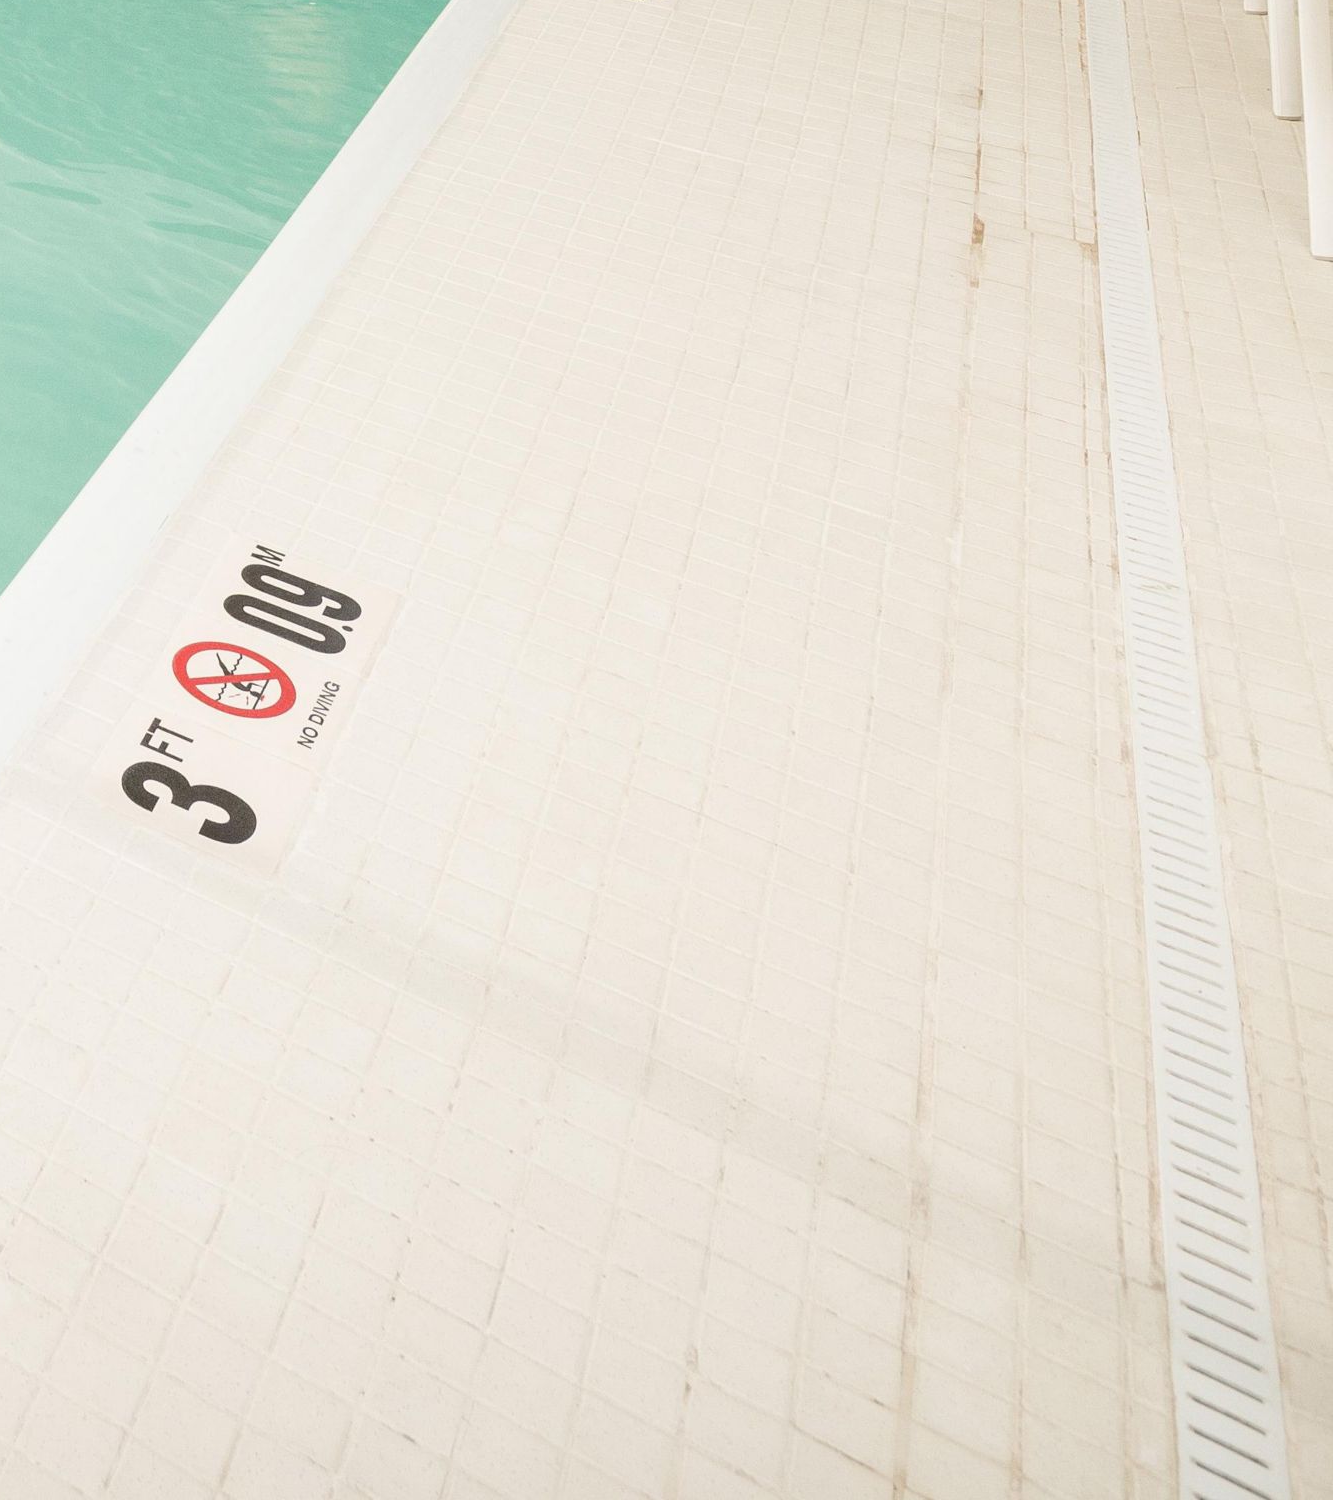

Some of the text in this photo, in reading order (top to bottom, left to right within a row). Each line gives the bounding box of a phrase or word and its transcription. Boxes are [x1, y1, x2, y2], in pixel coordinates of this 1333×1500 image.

[121, 544, 362, 845] 3 FT 0.9 M
[297, 681, 341, 750] NO DIVING
